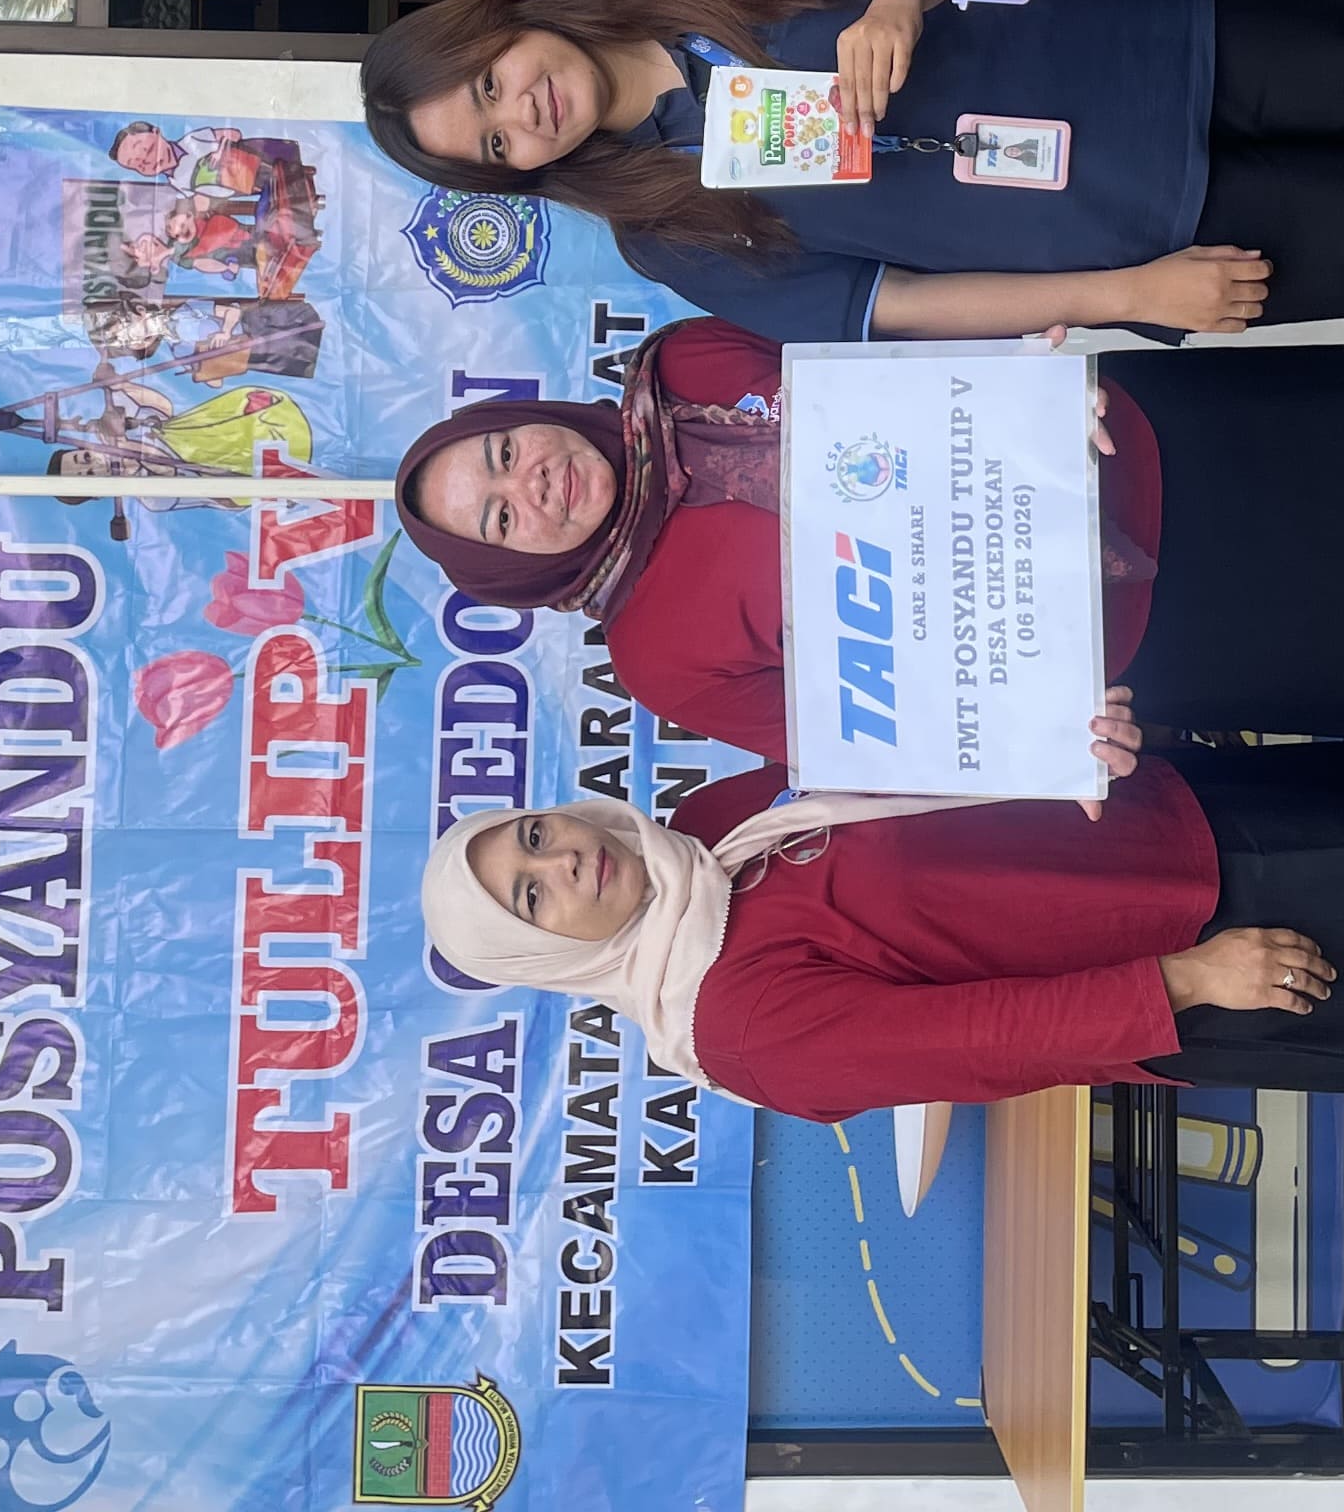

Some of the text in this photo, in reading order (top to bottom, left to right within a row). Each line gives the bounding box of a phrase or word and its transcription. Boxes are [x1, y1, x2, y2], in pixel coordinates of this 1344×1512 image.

[763, 93, 782, 162] Promina
[910, 505, 927, 641] CARE & SHARE
[949, 376, 981, 771] PMT POSYANDU TULIP V
[984, 458, 1008, 685] DESA CIKEDOKAN
[1012, 484, 1036, 550] 2026)
[1015, 558, 1034, 605] FEB
[1016, 612, 1035, 641] 06
[232, 448, 375, 1213] TULIP V
[419, 1020, 517, 1305] DESA
[557, 1004, 621, 1385] KECAMATA
